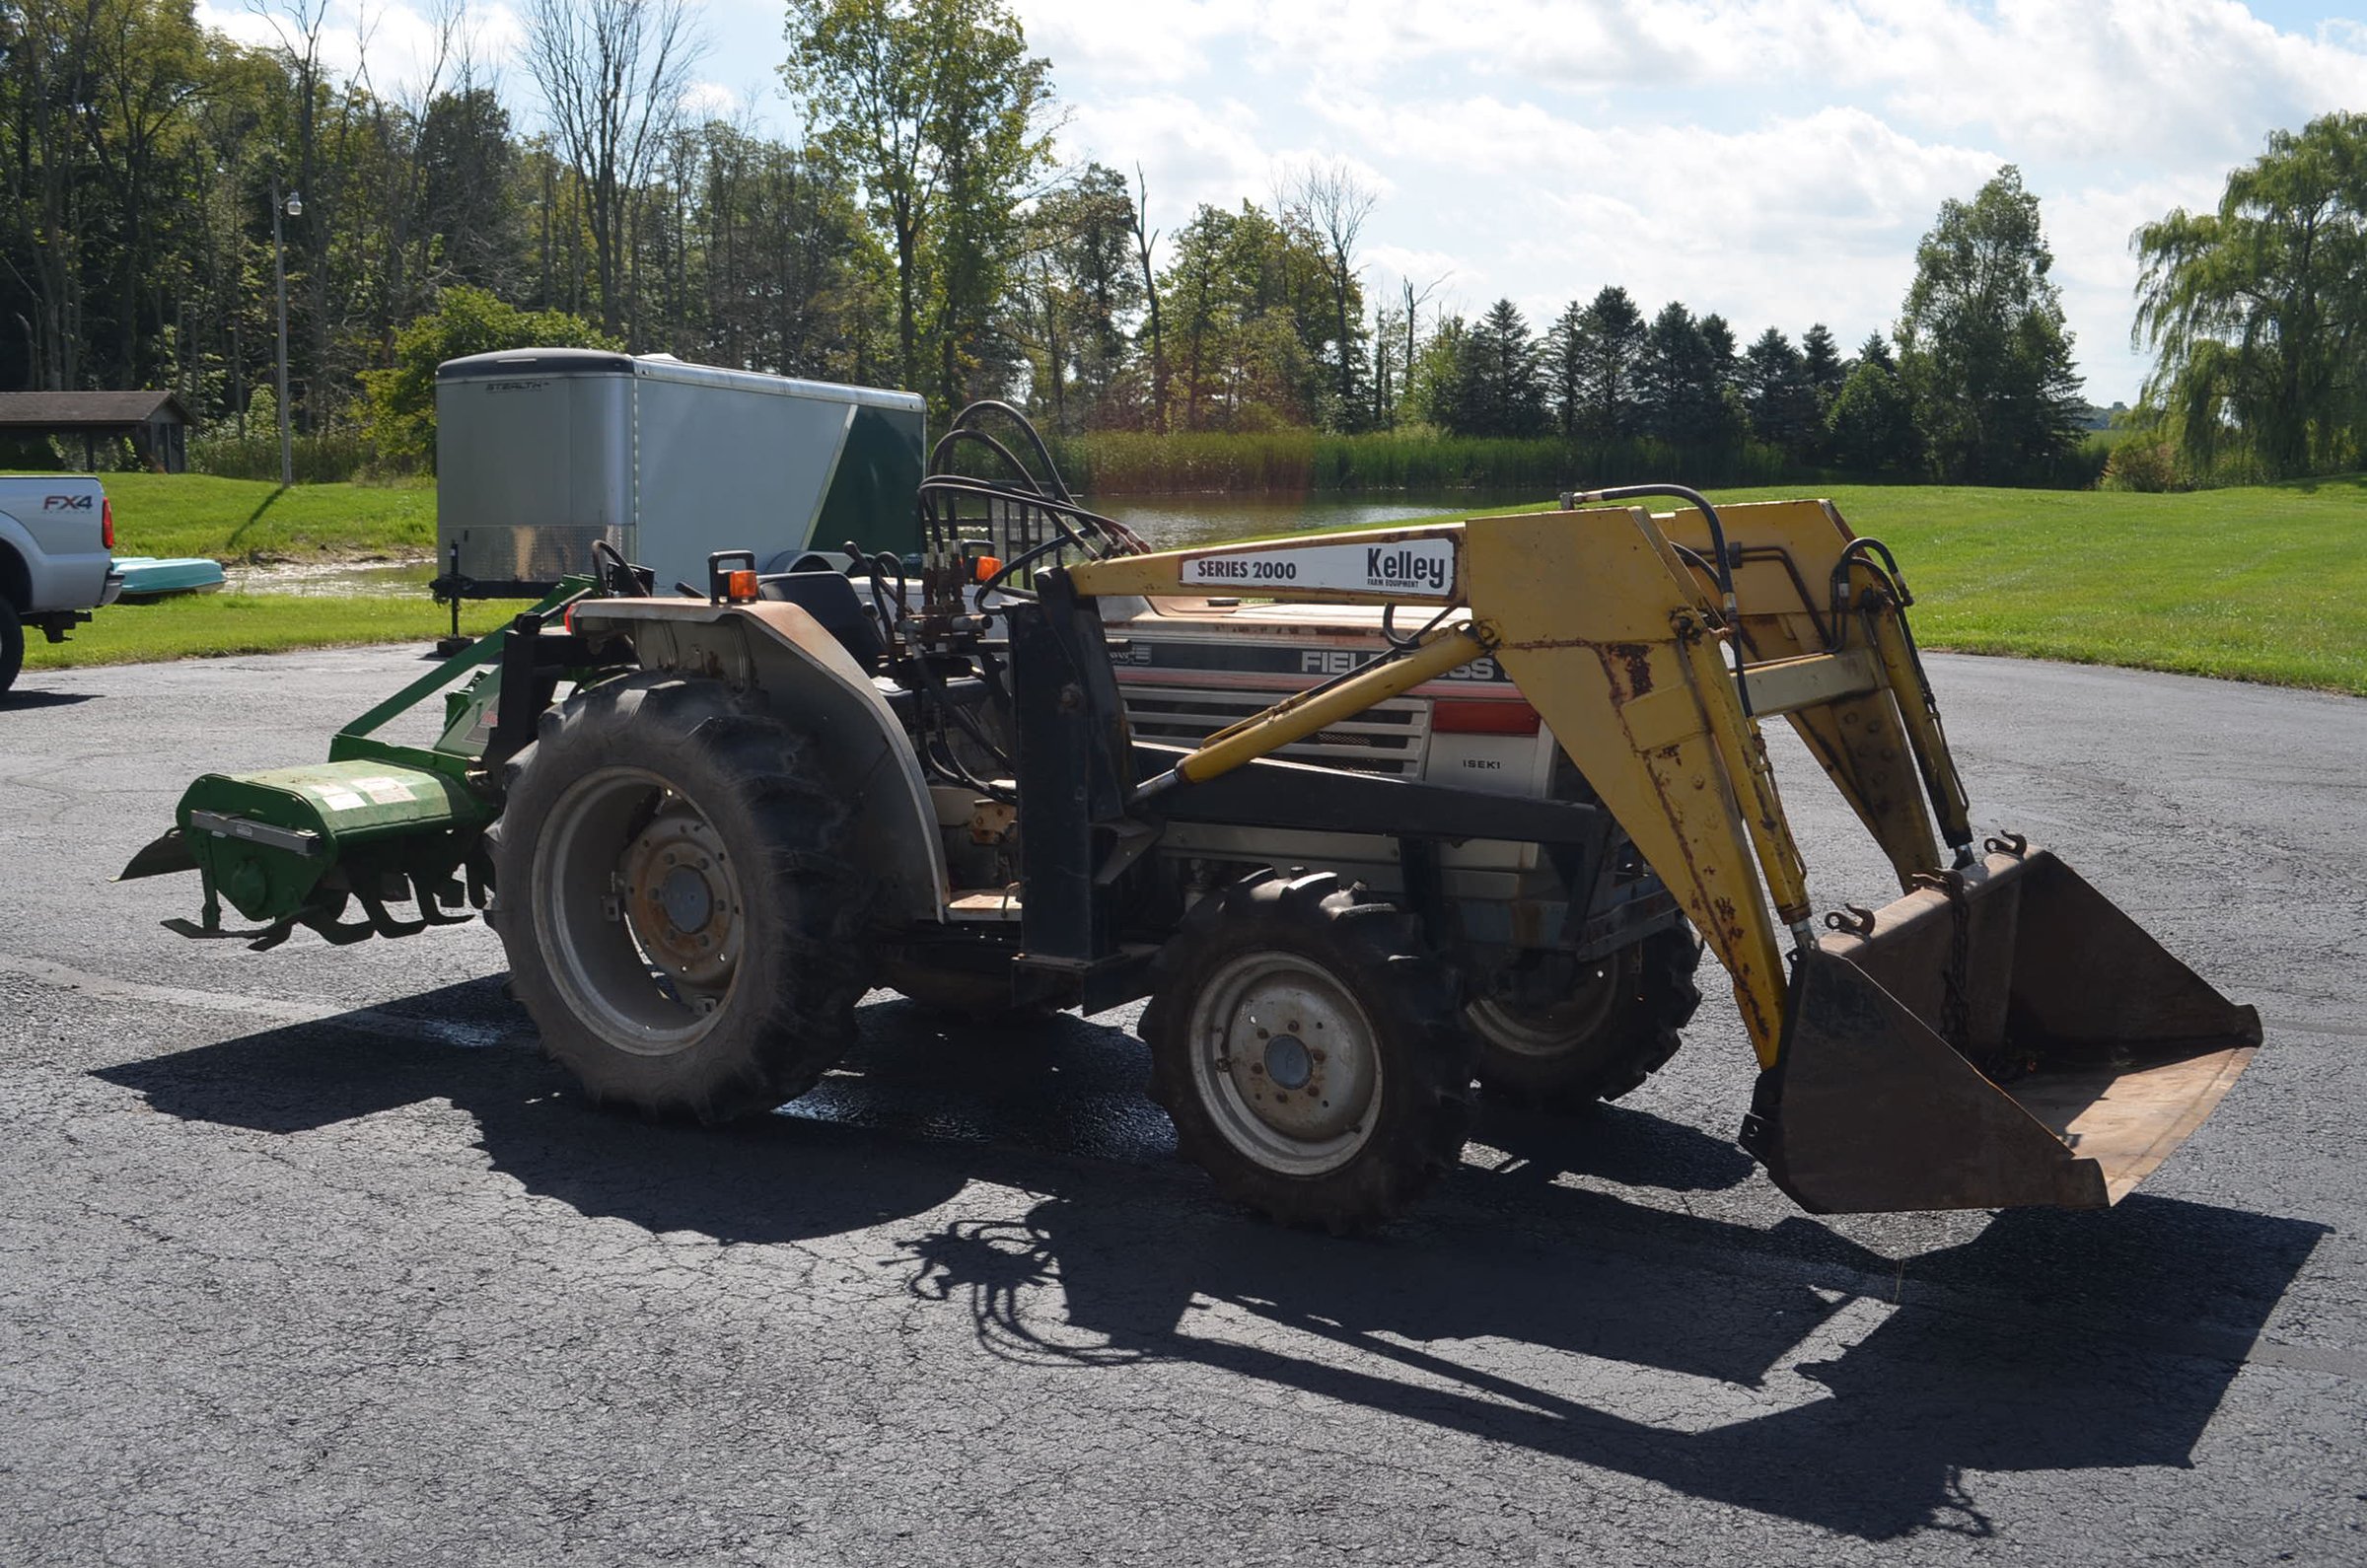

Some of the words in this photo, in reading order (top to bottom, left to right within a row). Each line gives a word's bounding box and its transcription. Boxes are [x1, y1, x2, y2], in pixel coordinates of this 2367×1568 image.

[43, 495, 93, 510] FX4
[1197, 560, 1249, 578] SERIES
[1253, 561, 1297, 580] 2000
[1367, 547, 1446, 590] Kelley
[1367, 578, 1384, 587] FARM
[1385, 579, 1419, 589] EQUIPMENT
[1463, 758, 1501, 769] ISEKI
